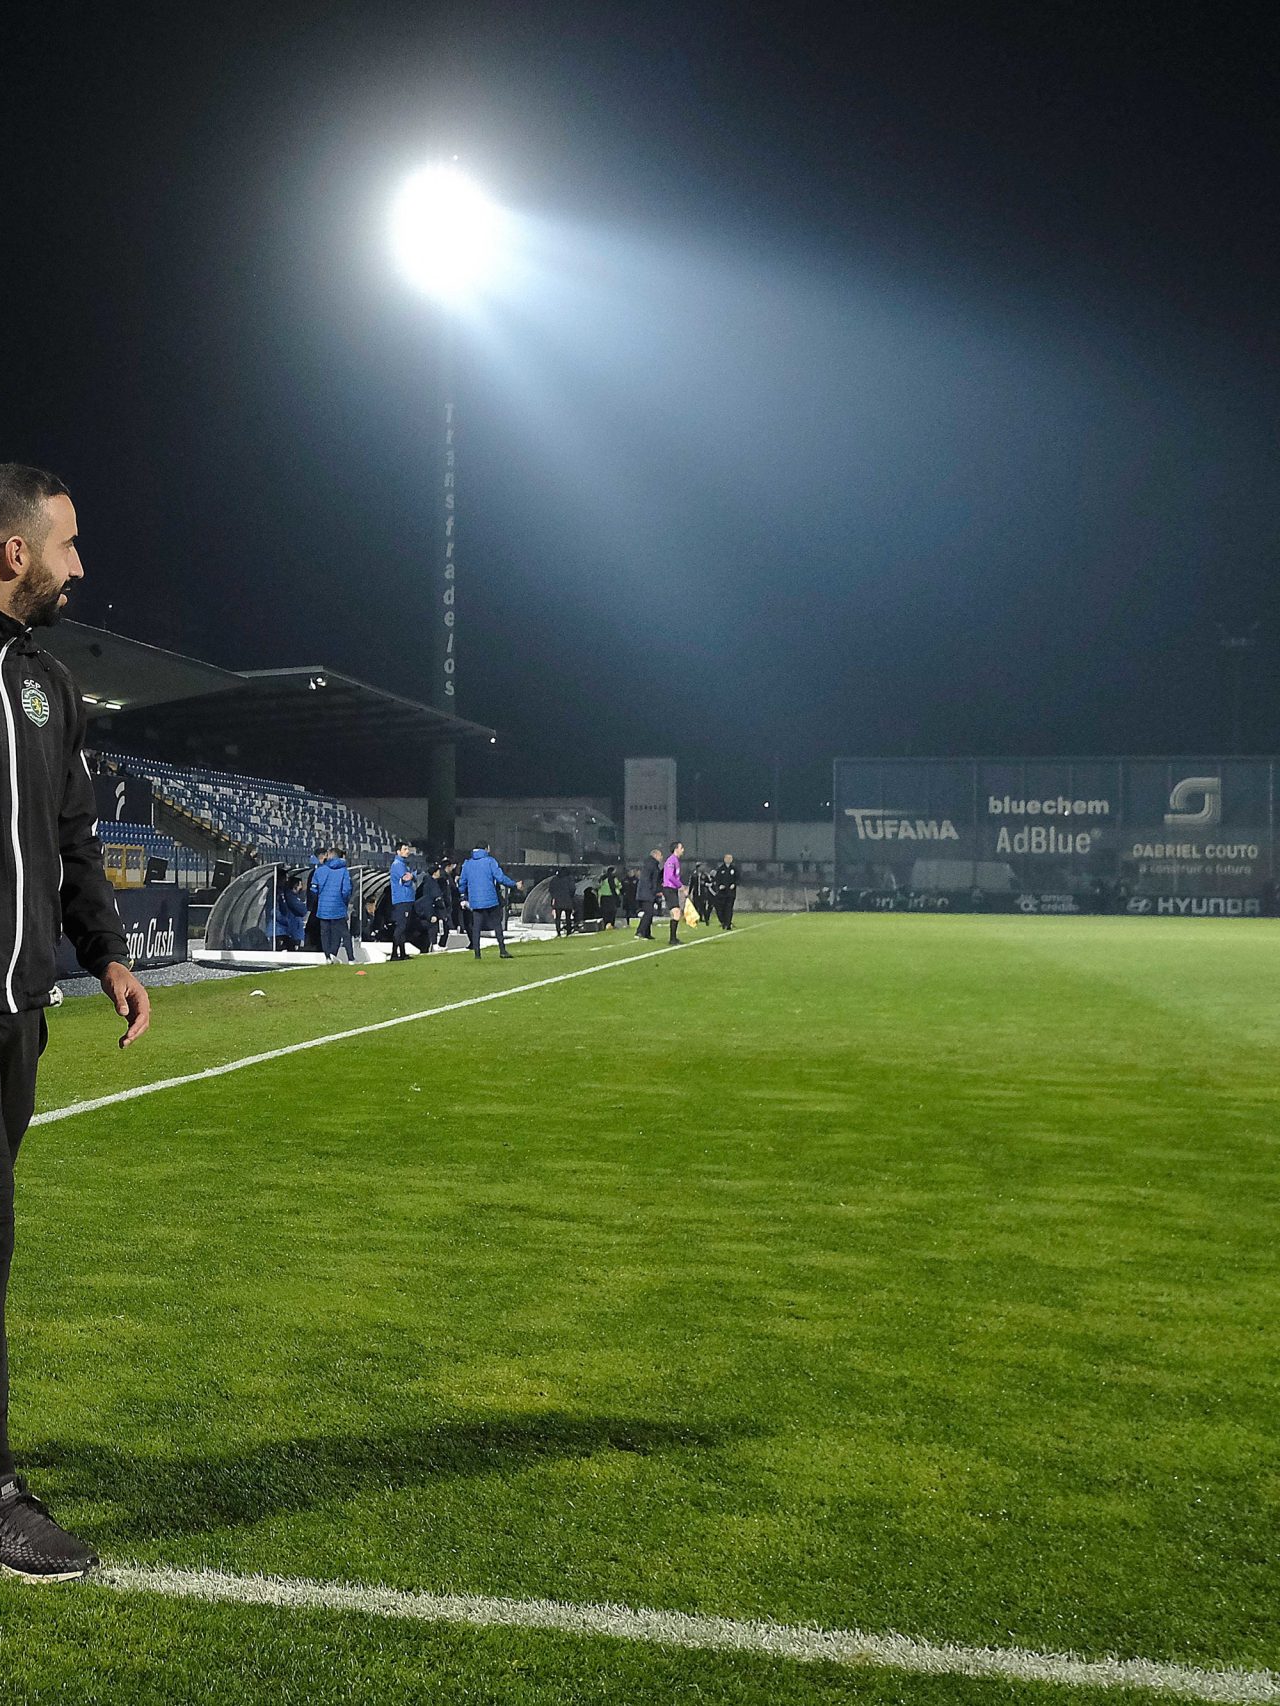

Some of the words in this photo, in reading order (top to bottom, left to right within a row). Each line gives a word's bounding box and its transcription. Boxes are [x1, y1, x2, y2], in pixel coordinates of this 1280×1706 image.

[988, 795, 1110, 815] bluechem
[844, 808, 960, 840] TUFAMA
[1132, 843, 1201, 859] GABRIEL
[1205, 843, 1259, 859] COUTO
[1157, 896, 1261, 914] HYUNDA
[146, 917, 175, 959] Cash
